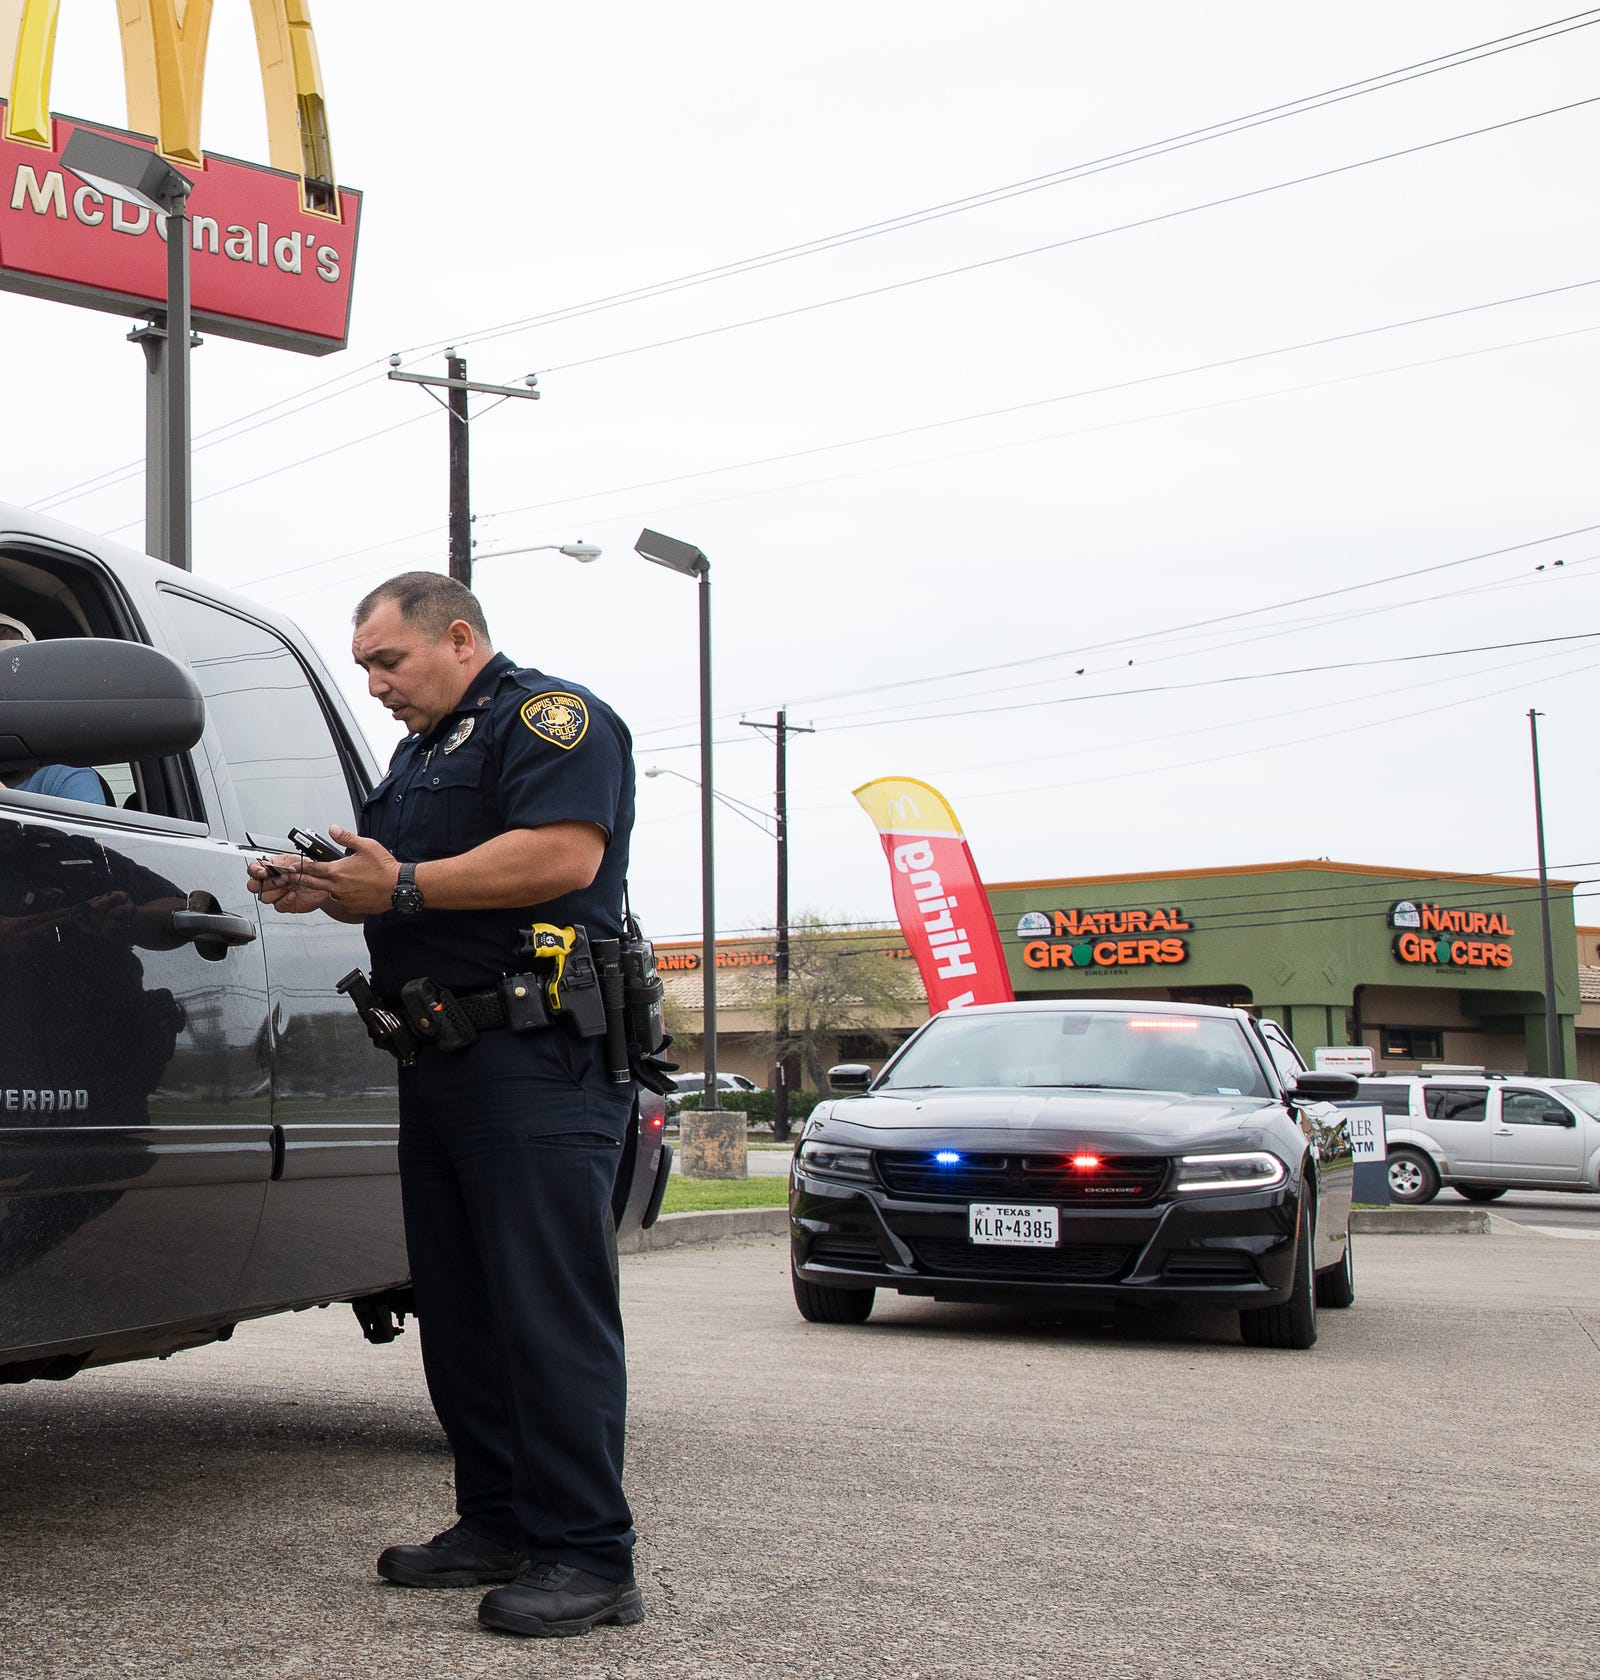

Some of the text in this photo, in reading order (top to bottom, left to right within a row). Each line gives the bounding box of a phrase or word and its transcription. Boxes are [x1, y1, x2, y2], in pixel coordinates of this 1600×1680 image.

[10, 163, 340, 282] McDnald's
[526, 696, 582, 719] CORPUS CHRISTI
[549, 724, 577, 736] POLICE
[1054, 908, 1189, 936] NATURAL
[1422, 903, 1515, 936] NATURAL
[656, 951, 775, 970] ANIC RODUC
[1350, 1119, 1374, 1137] LER
[997, 1208, 1031, 1217] TEXAS
